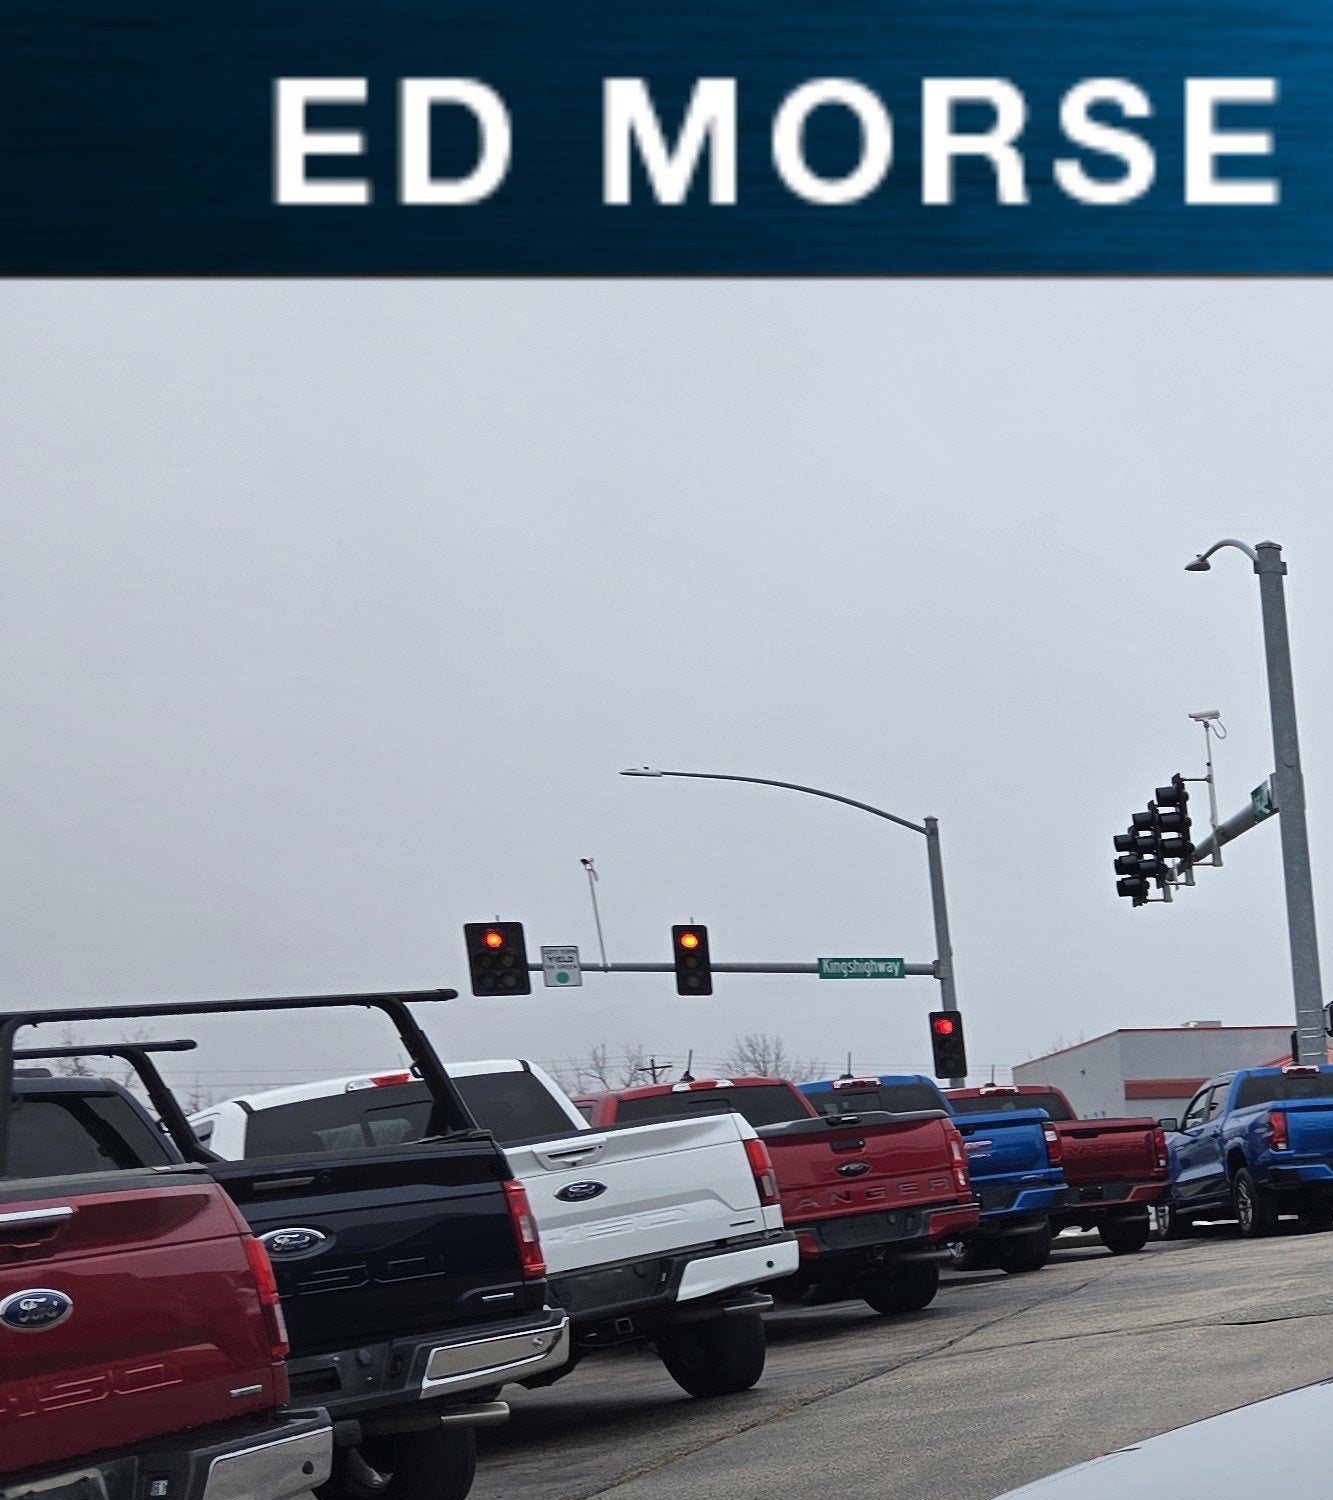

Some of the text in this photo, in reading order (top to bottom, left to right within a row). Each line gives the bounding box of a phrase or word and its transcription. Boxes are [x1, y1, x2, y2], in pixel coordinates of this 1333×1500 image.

[546, 955, 575, 963] YIELD
[822, 959, 900, 977] Kingshighway
[794, 1176, 950, 1211] ANGER
